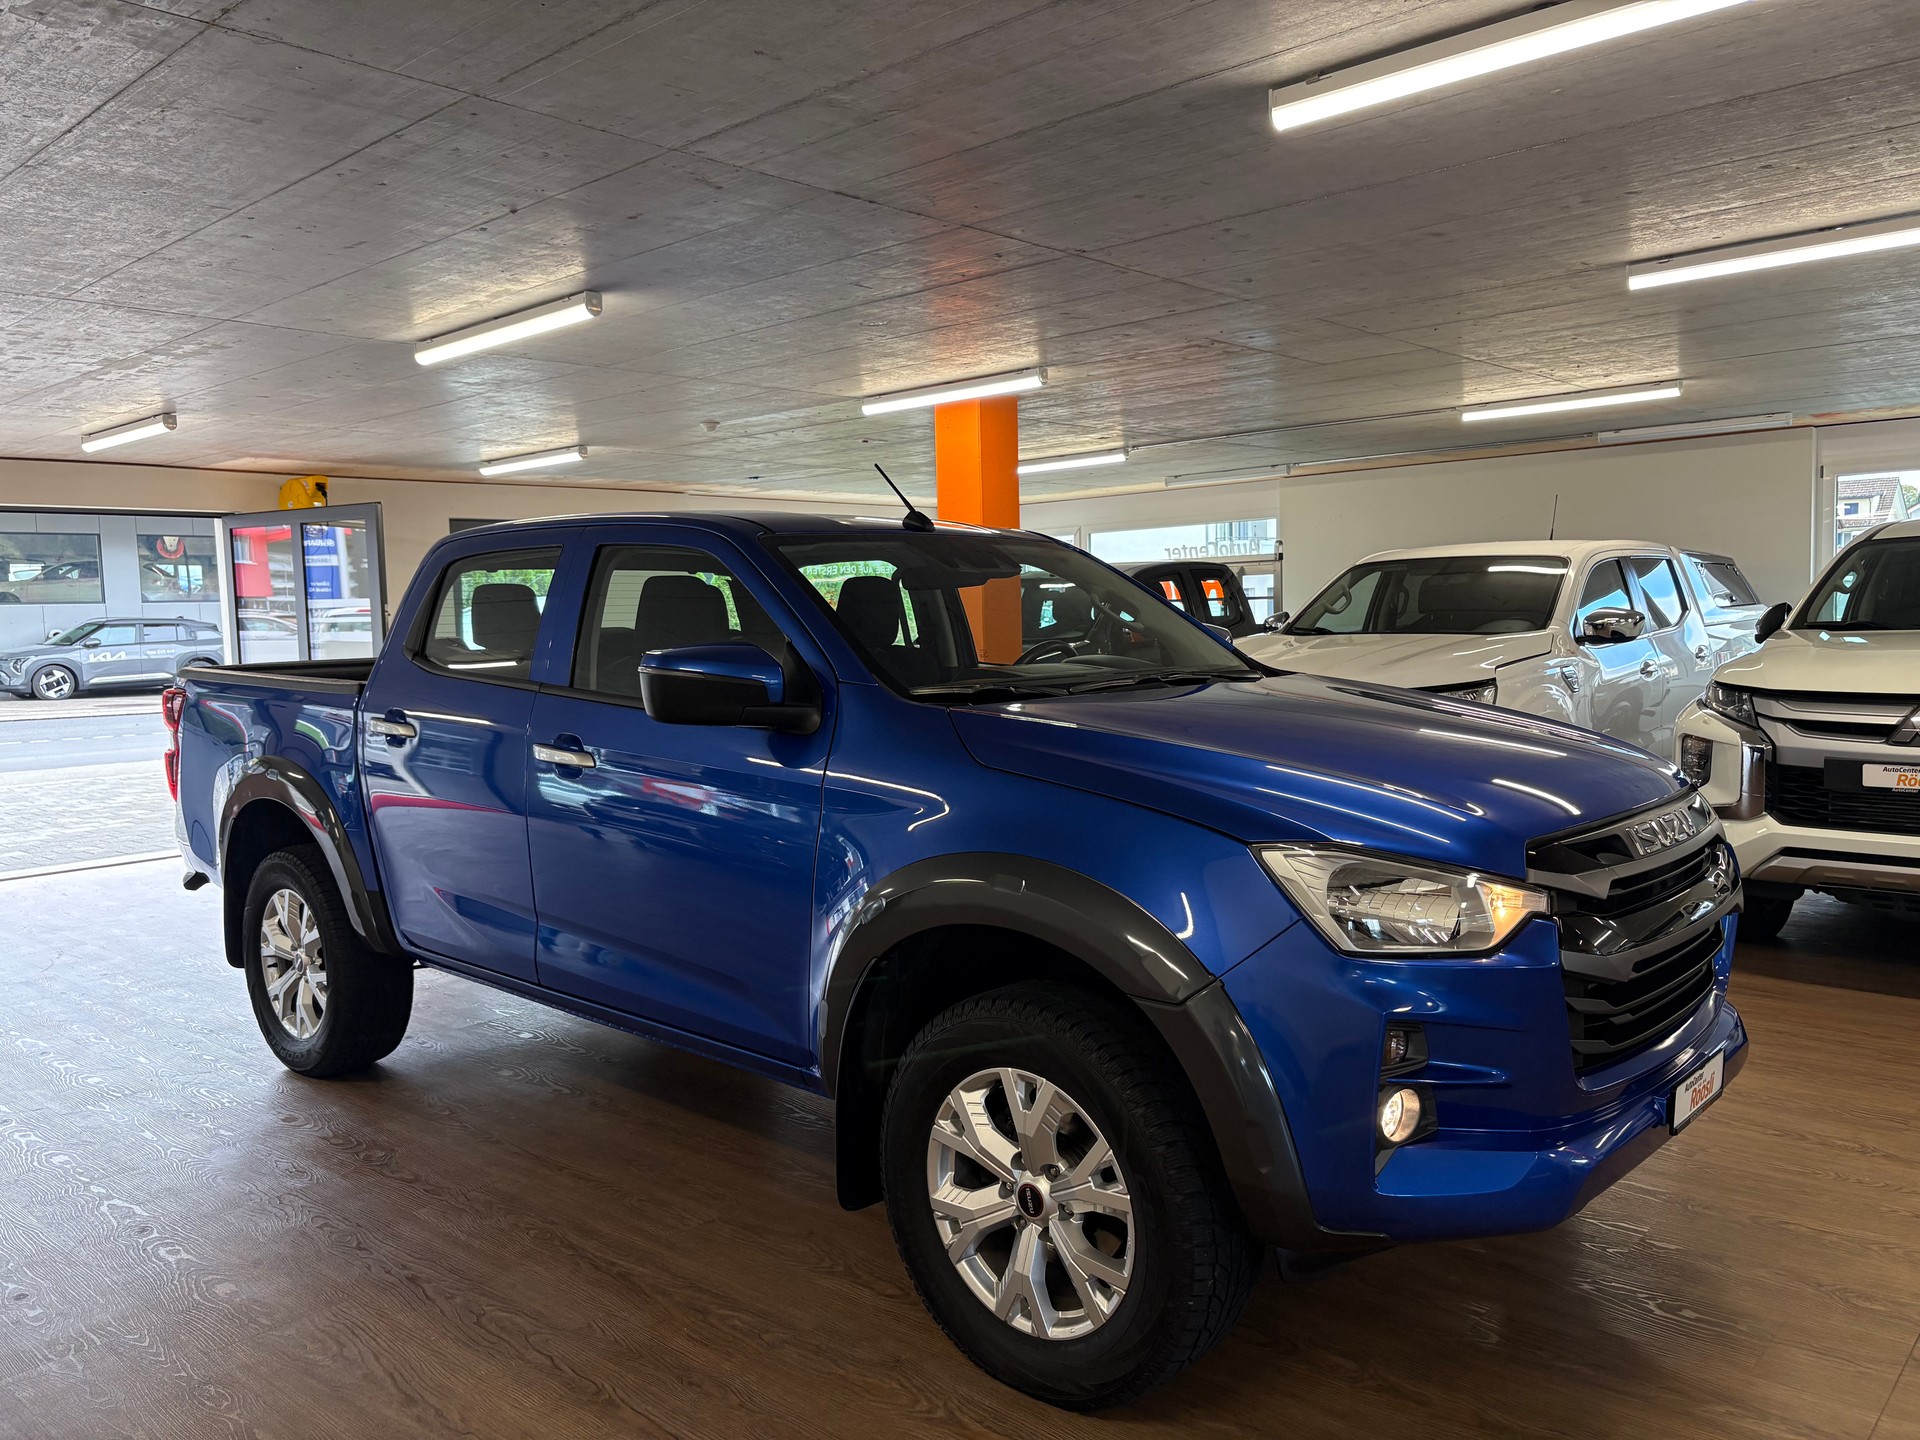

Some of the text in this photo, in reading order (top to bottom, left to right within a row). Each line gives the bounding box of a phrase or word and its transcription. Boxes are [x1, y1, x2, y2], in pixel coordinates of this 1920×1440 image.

[88, 651, 126, 662] KIA
[1626, 808, 1697, 856] ISUZU
[1684, 1071, 1704, 1093] AutoCenter
[1025, 1187, 1035, 1215] ISUZU
